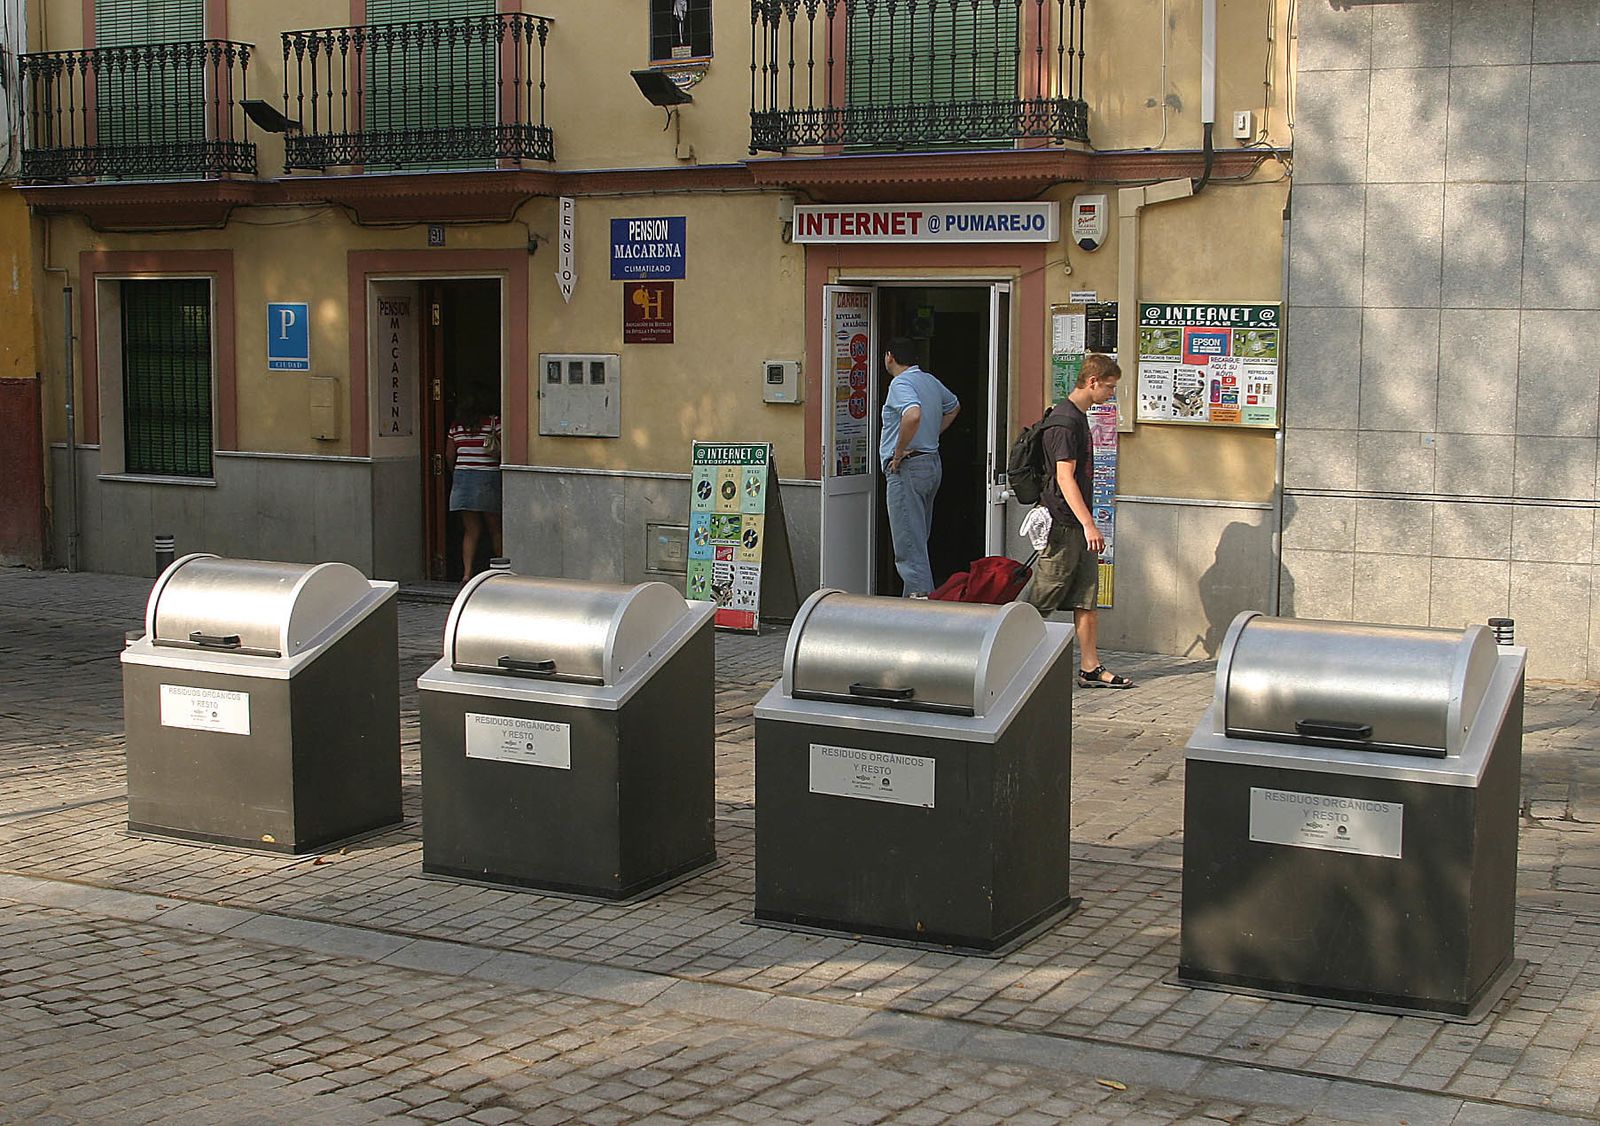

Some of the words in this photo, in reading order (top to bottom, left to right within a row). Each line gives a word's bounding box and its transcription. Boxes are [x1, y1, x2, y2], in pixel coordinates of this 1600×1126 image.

[629, 220, 668, 240] PENSION
[798, 212, 922, 236] INTERNET
[928, 214, 940, 234] @
[946, 214, 1045, 231] PUMAREJO
[562, 202, 571, 294] PENSION
[614, 243, 682, 258] MACARENA
[380, 301, 410, 316] PENSION
[1146, 307, 1161, 319] @
[1166, 306, 1252, 321] INTERNET
[1260, 309, 1275, 321] @
[279, 309, 296, 340] P
[1192, 338, 1220, 346] EPSON
[390, 318, 400, 432] MACARENA
[697, 449, 705, 458] @
[707, 448, 752, 459] INTERNET
[169, 688, 201, 697] RESIDUOS
[197, 700, 218, 709] RESTO
[475, 716, 514, 727] RESIDUOS
[509, 730, 534, 740] RESTO
[822, 747, 867, 760] RESIDUOS
[861, 764, 892, 775] RESTO
[1264, 791, 1320, 806] RESIDUOS
[1302, 809, 1309, 818] Y
[1312, 810, 1349, 822] RESTO
